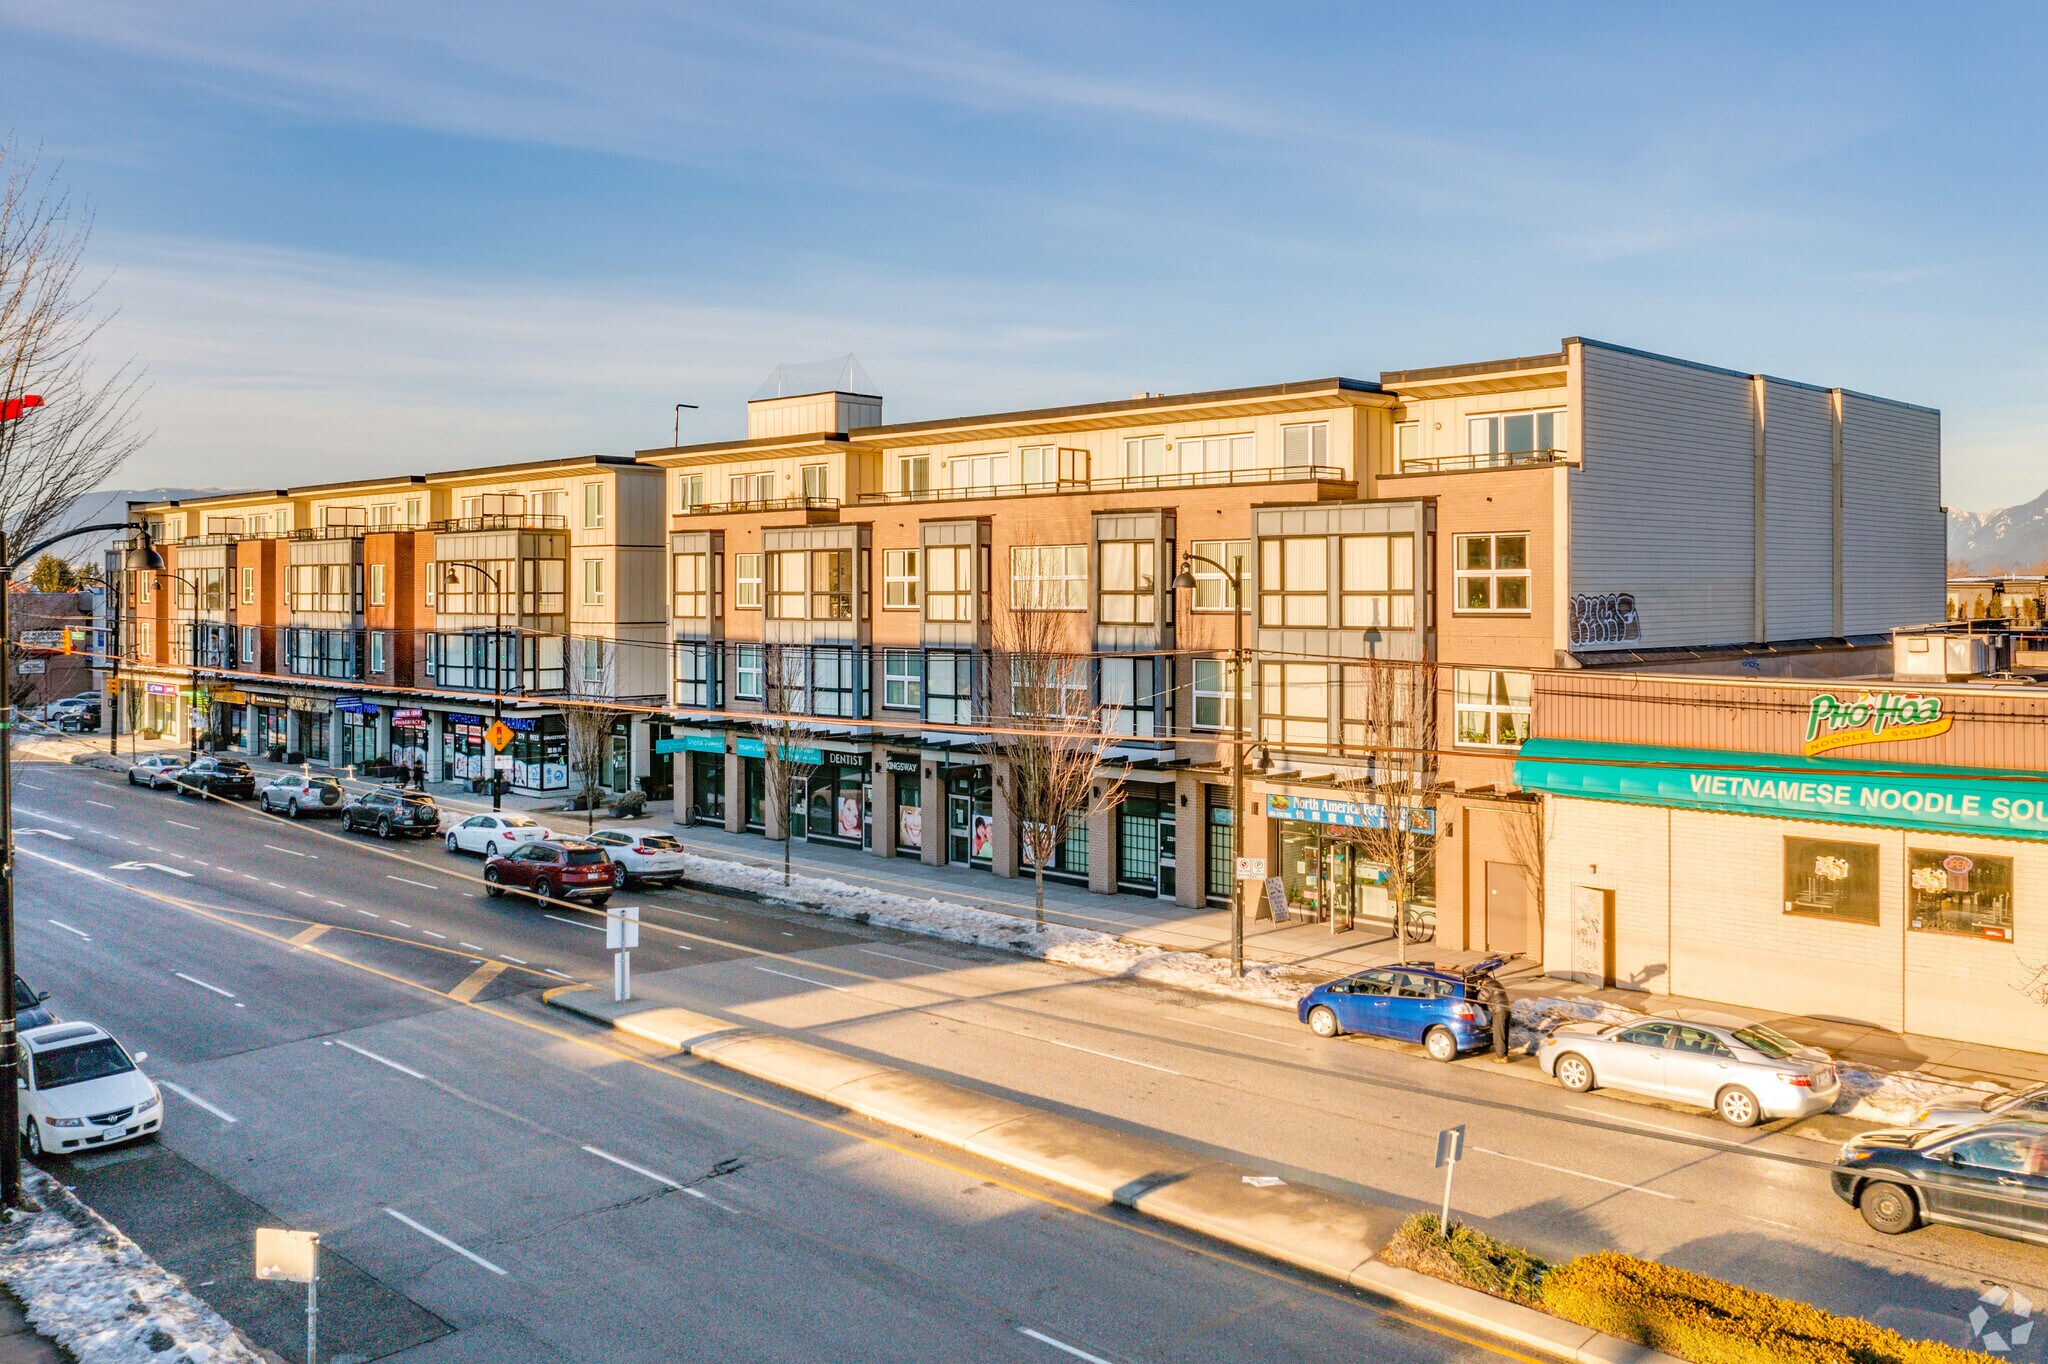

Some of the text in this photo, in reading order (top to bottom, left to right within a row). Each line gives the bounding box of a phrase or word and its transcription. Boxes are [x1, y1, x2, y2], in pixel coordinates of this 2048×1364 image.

[501, 716, 537, 732] HARMACY
[1810, 727, 1931, 751] NOODLE SOUP
[829, 753, 864, 766] DENTIST
[886, 761, 919, 772] KINGSWAY
[1690, 774, 1852, 806] VIETNAMESE
[1860, 787, 1981, 816] NOODLE
[1293, 797, 1319, 811] North
[1321, 800, 1361, 815] America
[1363, 804, 1379, 817] Pet
[1946, 858, 1969, 869] OPEN
